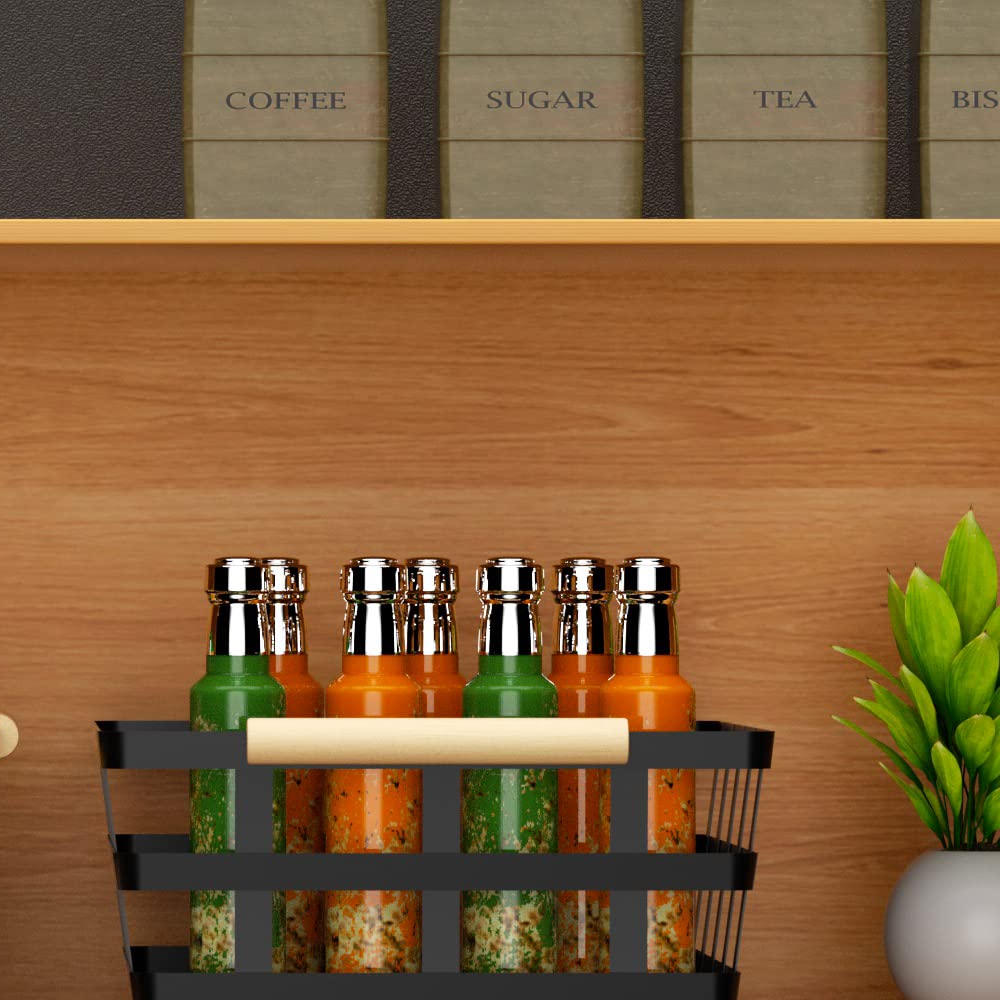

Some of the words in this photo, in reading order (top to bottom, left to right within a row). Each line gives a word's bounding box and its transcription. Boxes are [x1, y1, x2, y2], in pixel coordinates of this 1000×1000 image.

[225, 91, 347, 110] COFFEE
[486, 90, 598, 110] SUGAR
[753, 90, 817, 109] TEA
